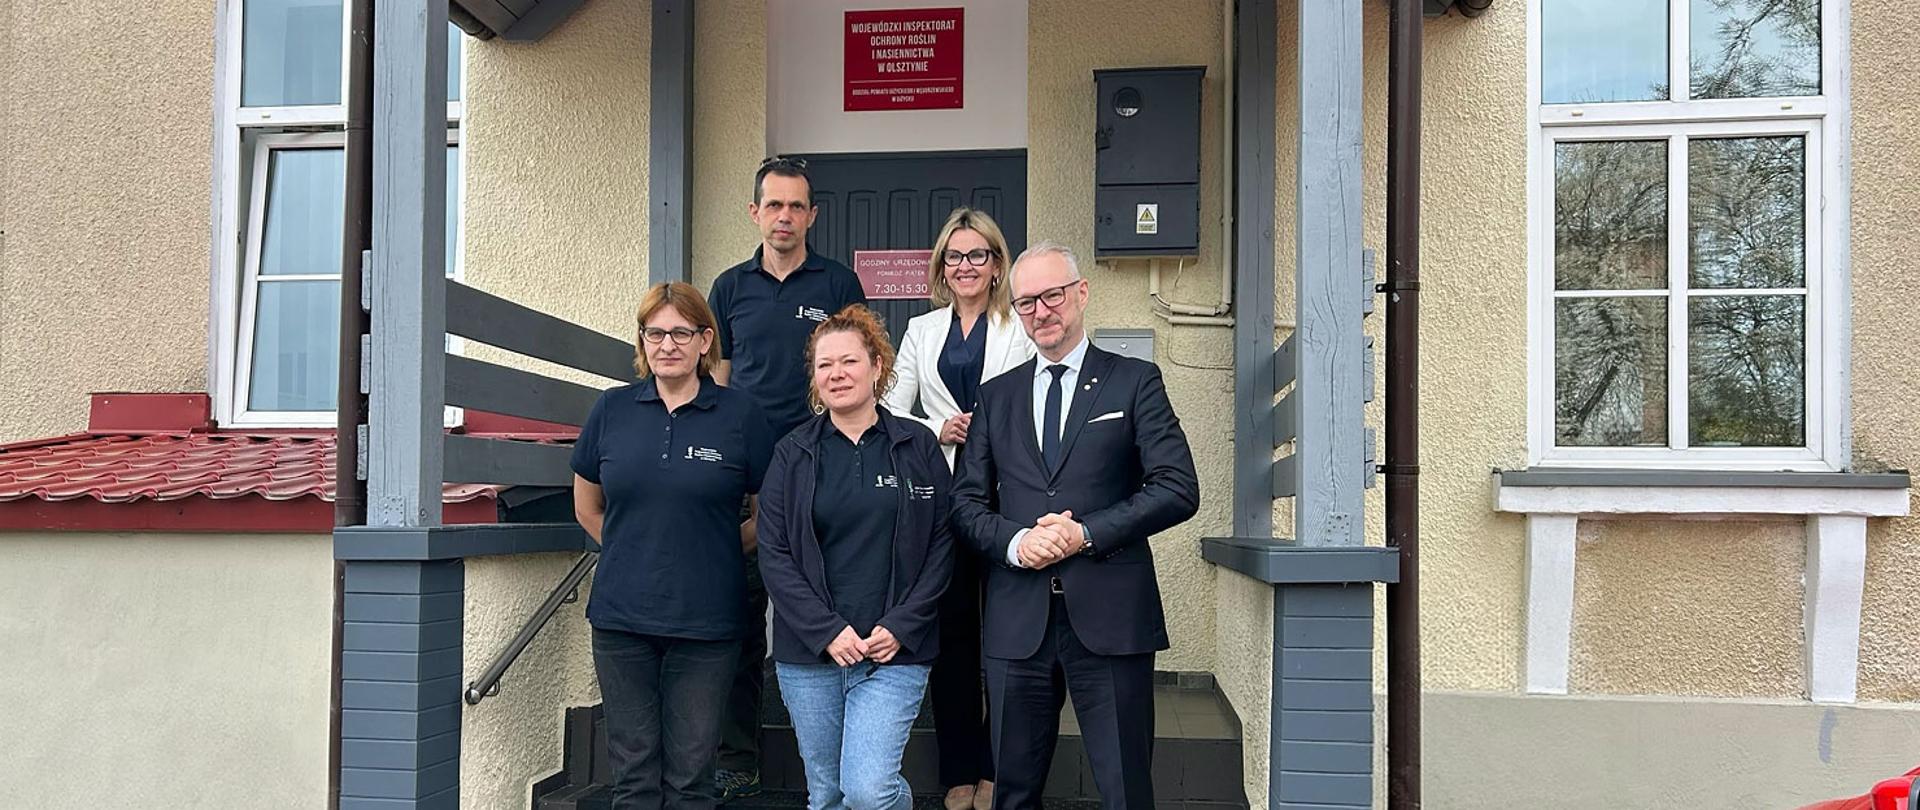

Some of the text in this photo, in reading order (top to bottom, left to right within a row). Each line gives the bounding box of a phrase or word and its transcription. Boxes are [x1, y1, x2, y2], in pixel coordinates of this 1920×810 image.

[851, 19, 955, 33] WOJEWÓDZKI INSPEKTORAT
[870, 34, 936, 46] OCHRONY ROŚLIN
[871, 48, 934, 60] I NASIENNICTWA
[878, 61, 929, 73] W OLSZTYNIE
[874, 283, 928, 294] 7.30-15.30
